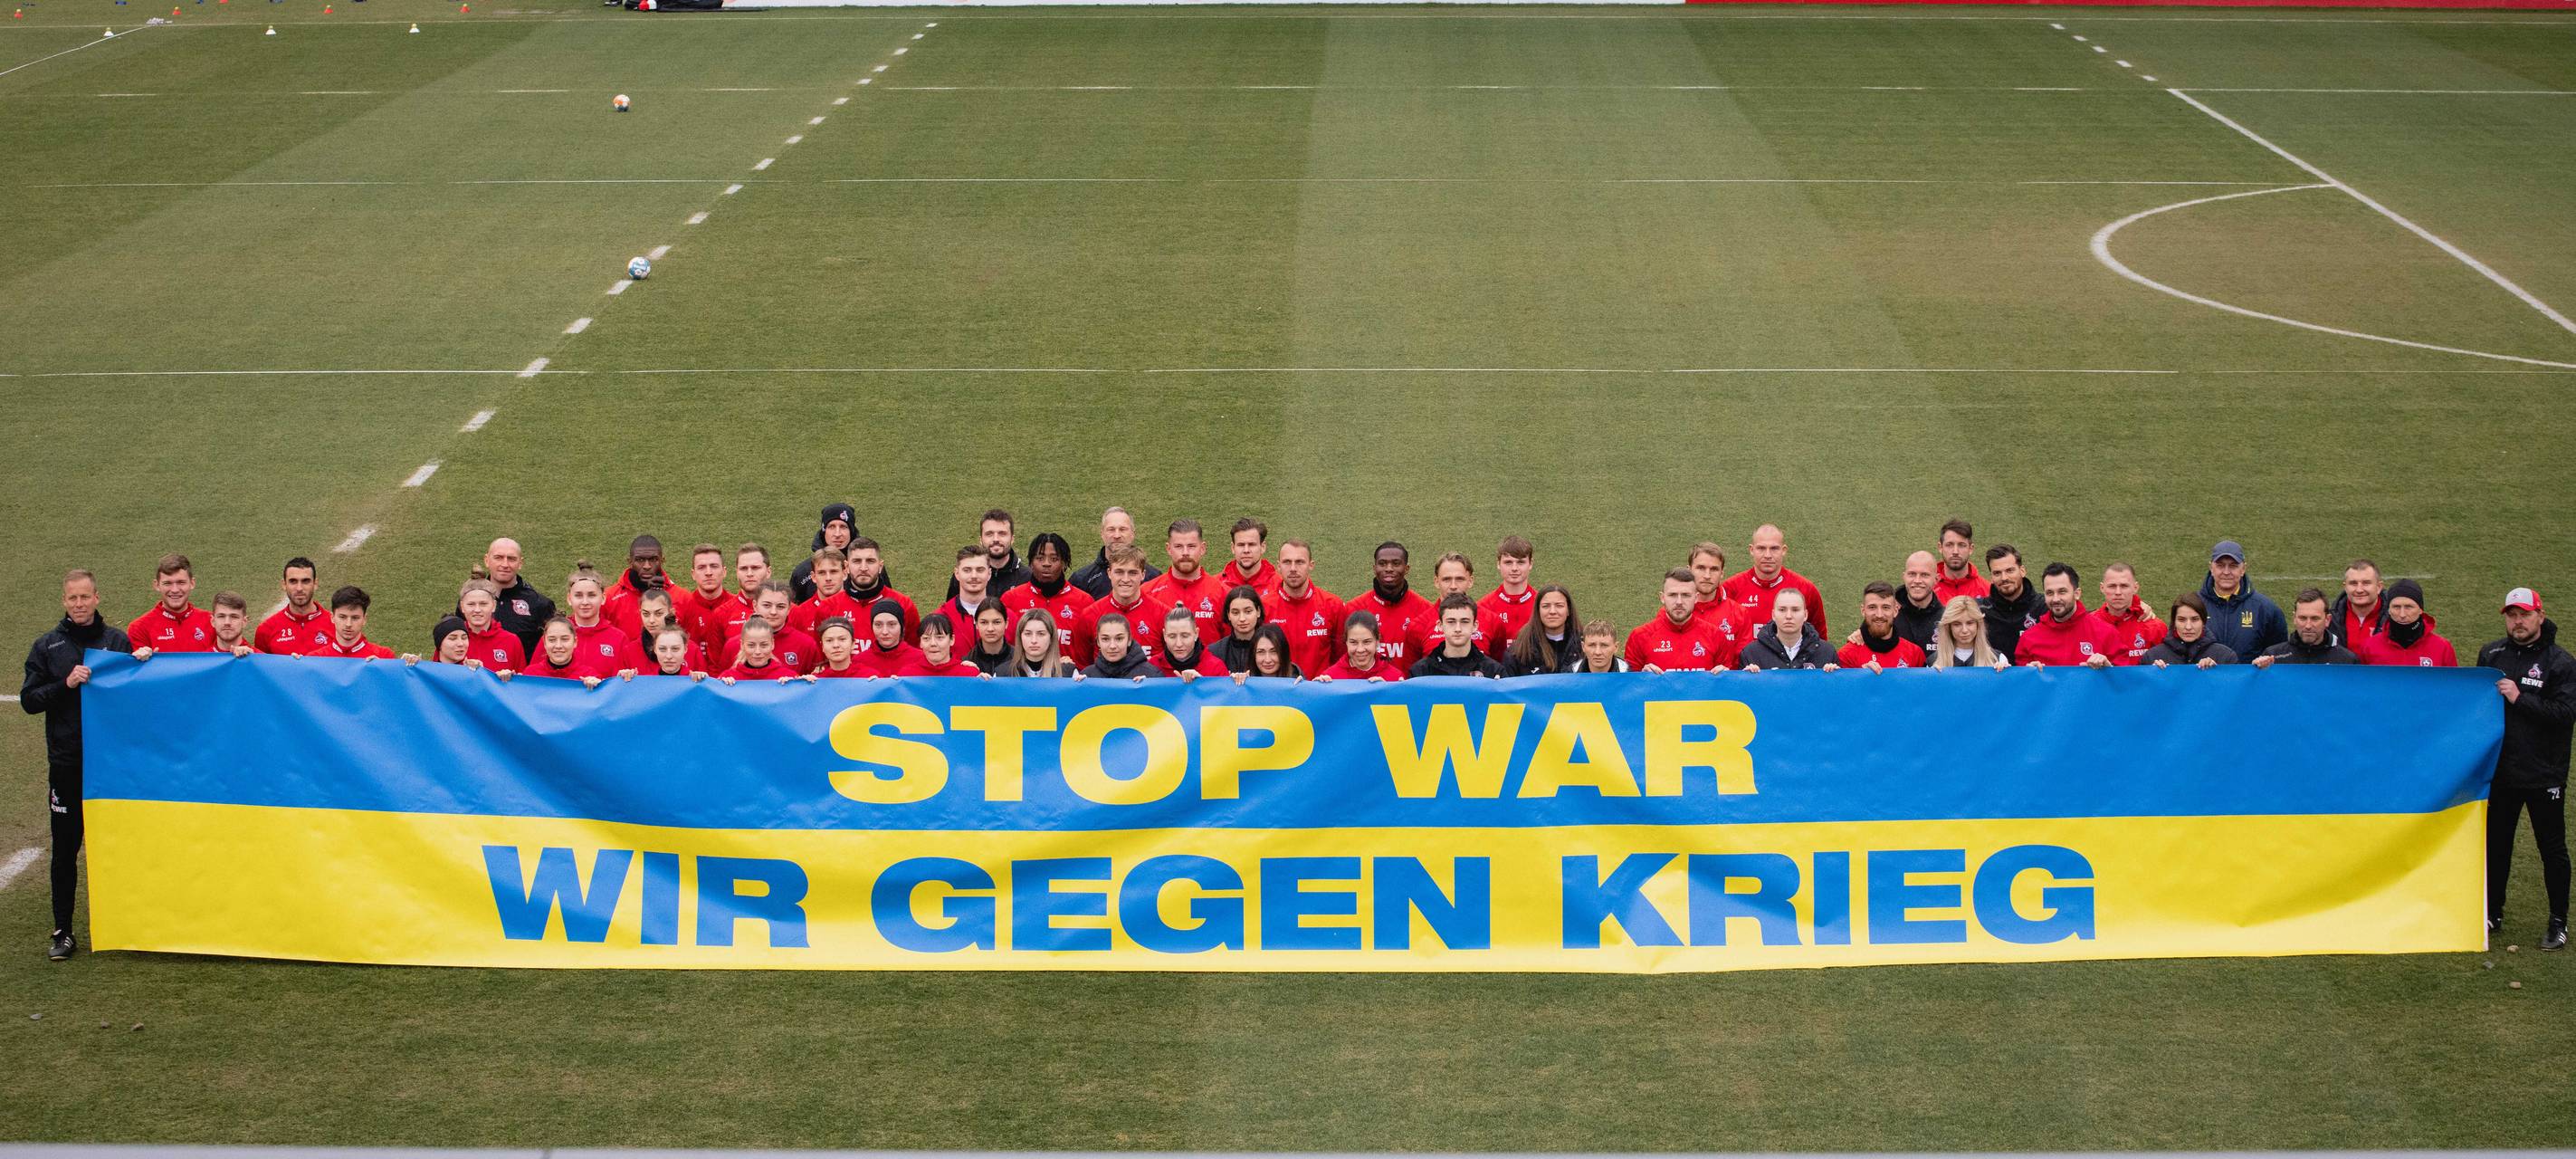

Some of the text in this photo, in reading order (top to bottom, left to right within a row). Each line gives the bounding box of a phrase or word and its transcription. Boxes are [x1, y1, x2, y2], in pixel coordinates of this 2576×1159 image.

[165, 627, 174, 636] 15
[1306, 628, 1328, 637] REWE
[1660, 640, 1671, 648] 23
[2521, 677, 2543, 688] REWE
[829, 700, 1756, 804] STOP WAR
[482, 845, 2094, 953] WIR GEGEN KRIEG
